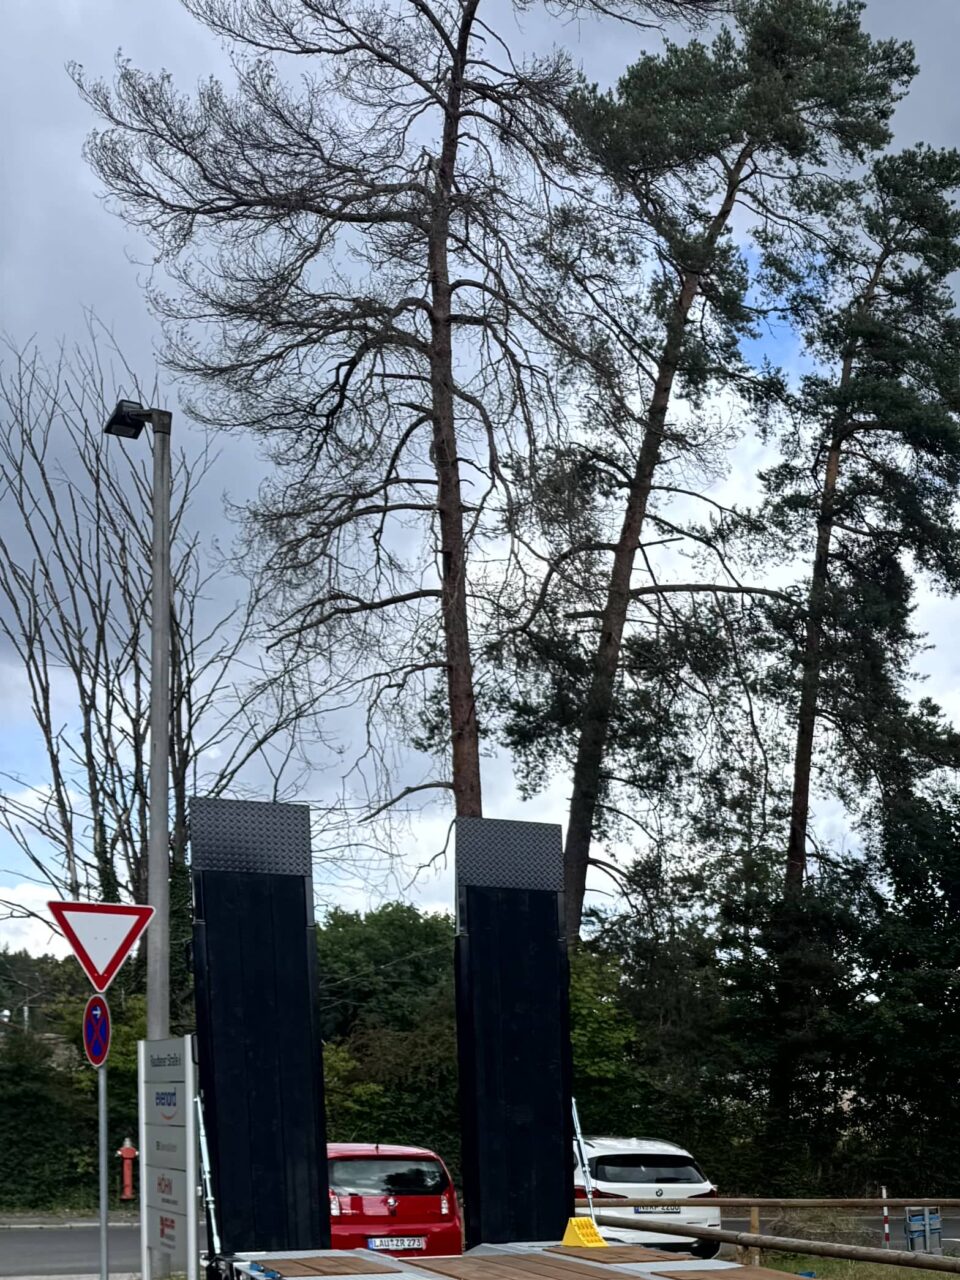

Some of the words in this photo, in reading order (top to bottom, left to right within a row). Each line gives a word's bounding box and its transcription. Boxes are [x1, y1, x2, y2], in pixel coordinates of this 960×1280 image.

[374, 1239, 390, 1248] LAU
[395, 1239, 405, 1247] ZR
[407, 1238, 421, 1247] 273
